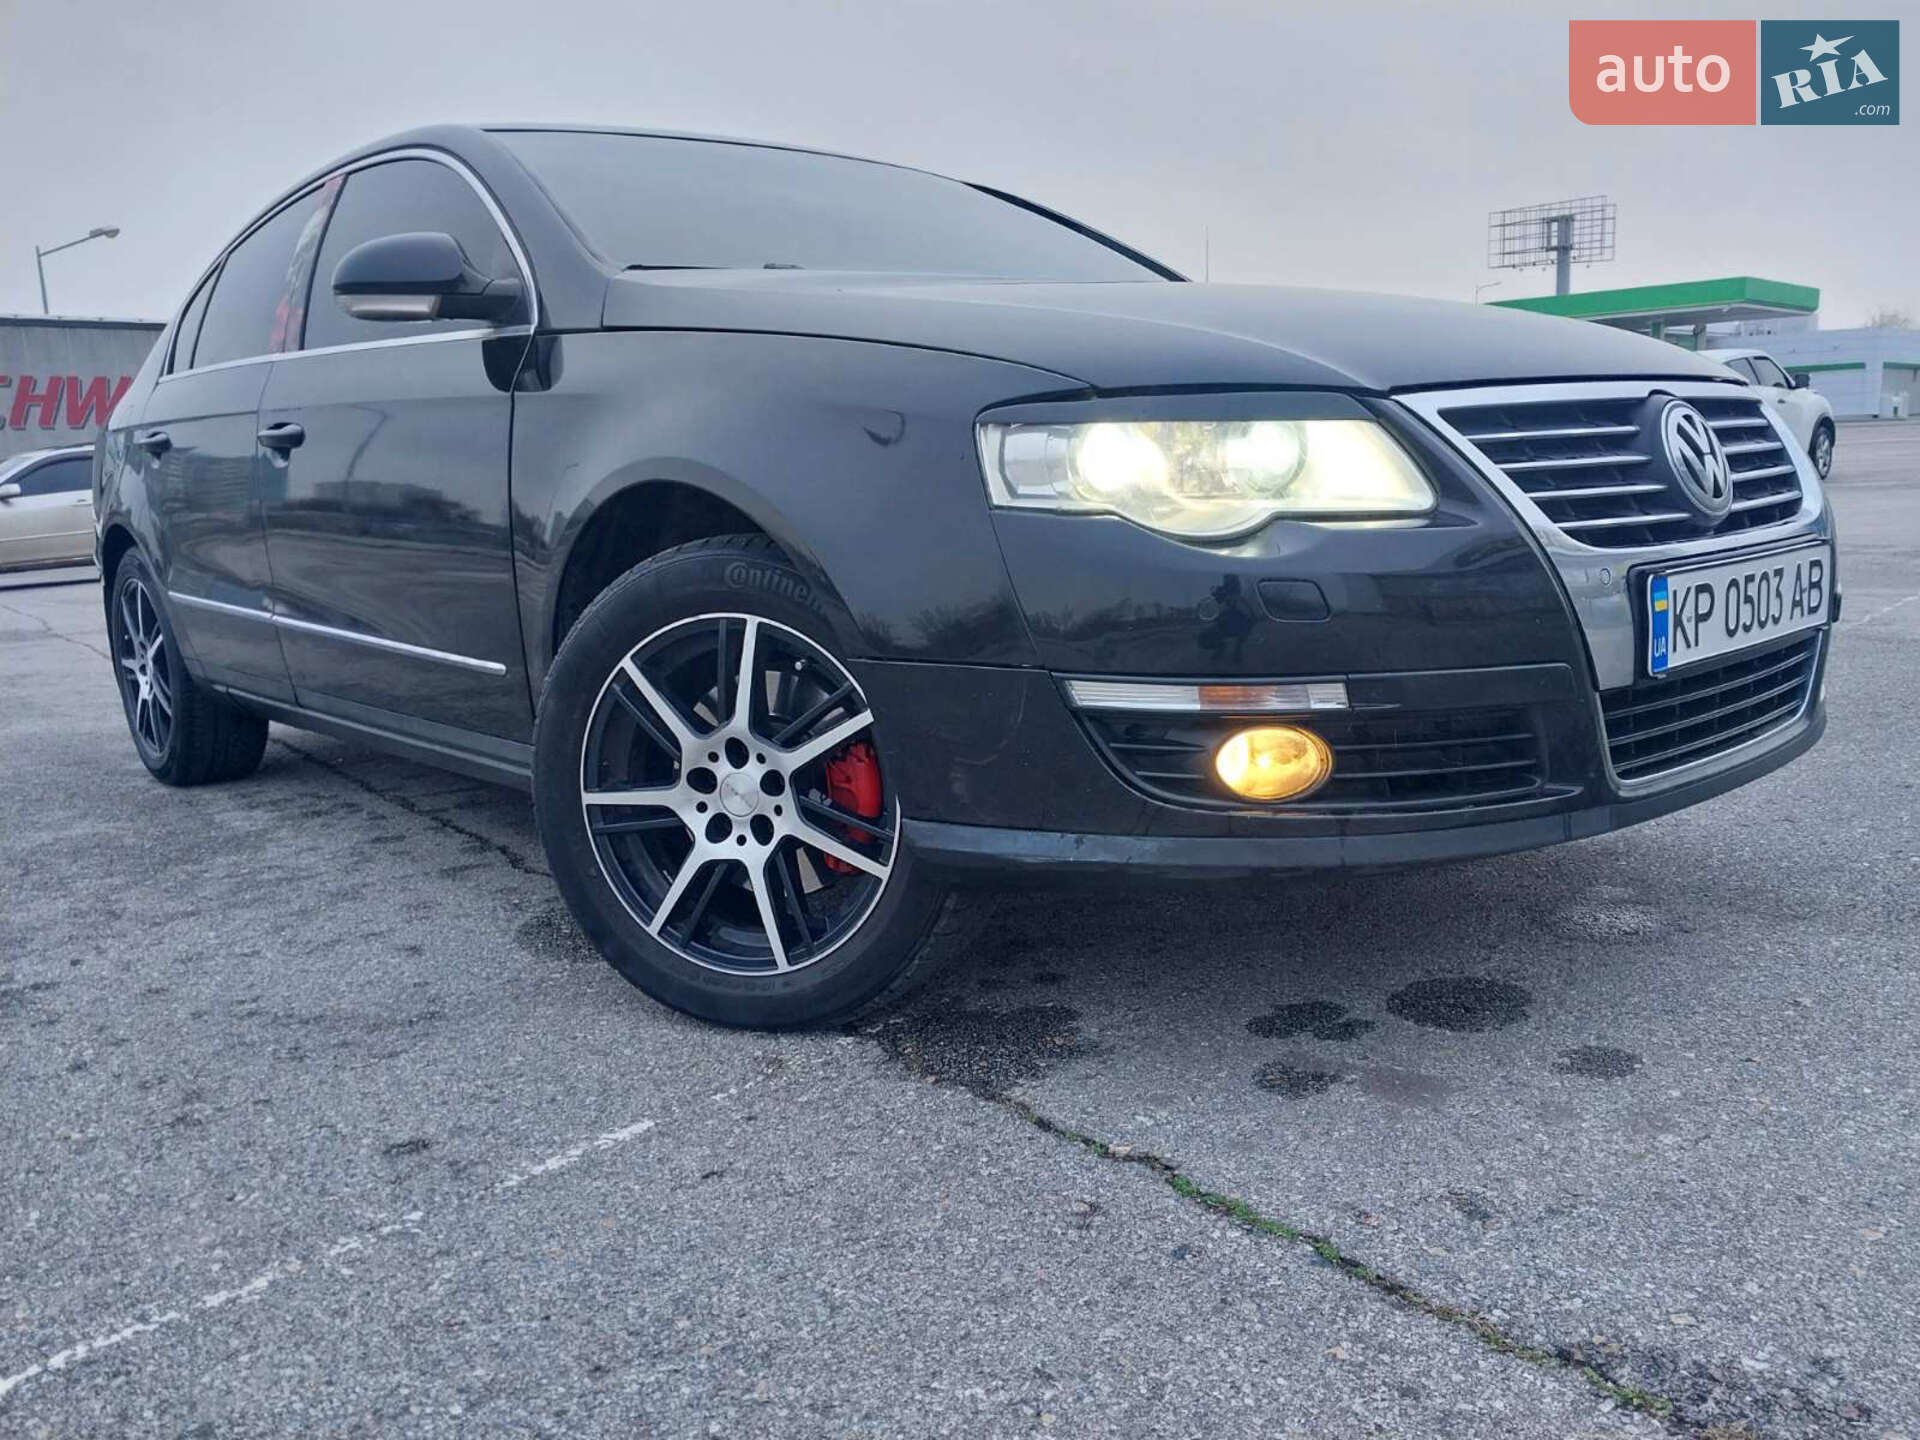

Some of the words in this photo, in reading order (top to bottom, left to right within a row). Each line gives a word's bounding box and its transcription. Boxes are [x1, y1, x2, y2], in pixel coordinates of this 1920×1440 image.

[1672, 582, 1715, 653] KP
[1725, 567, 1785, 638] 0503
[1790, 559, 1823, 620] AB
[1654, 637, 1667, 657] UA
